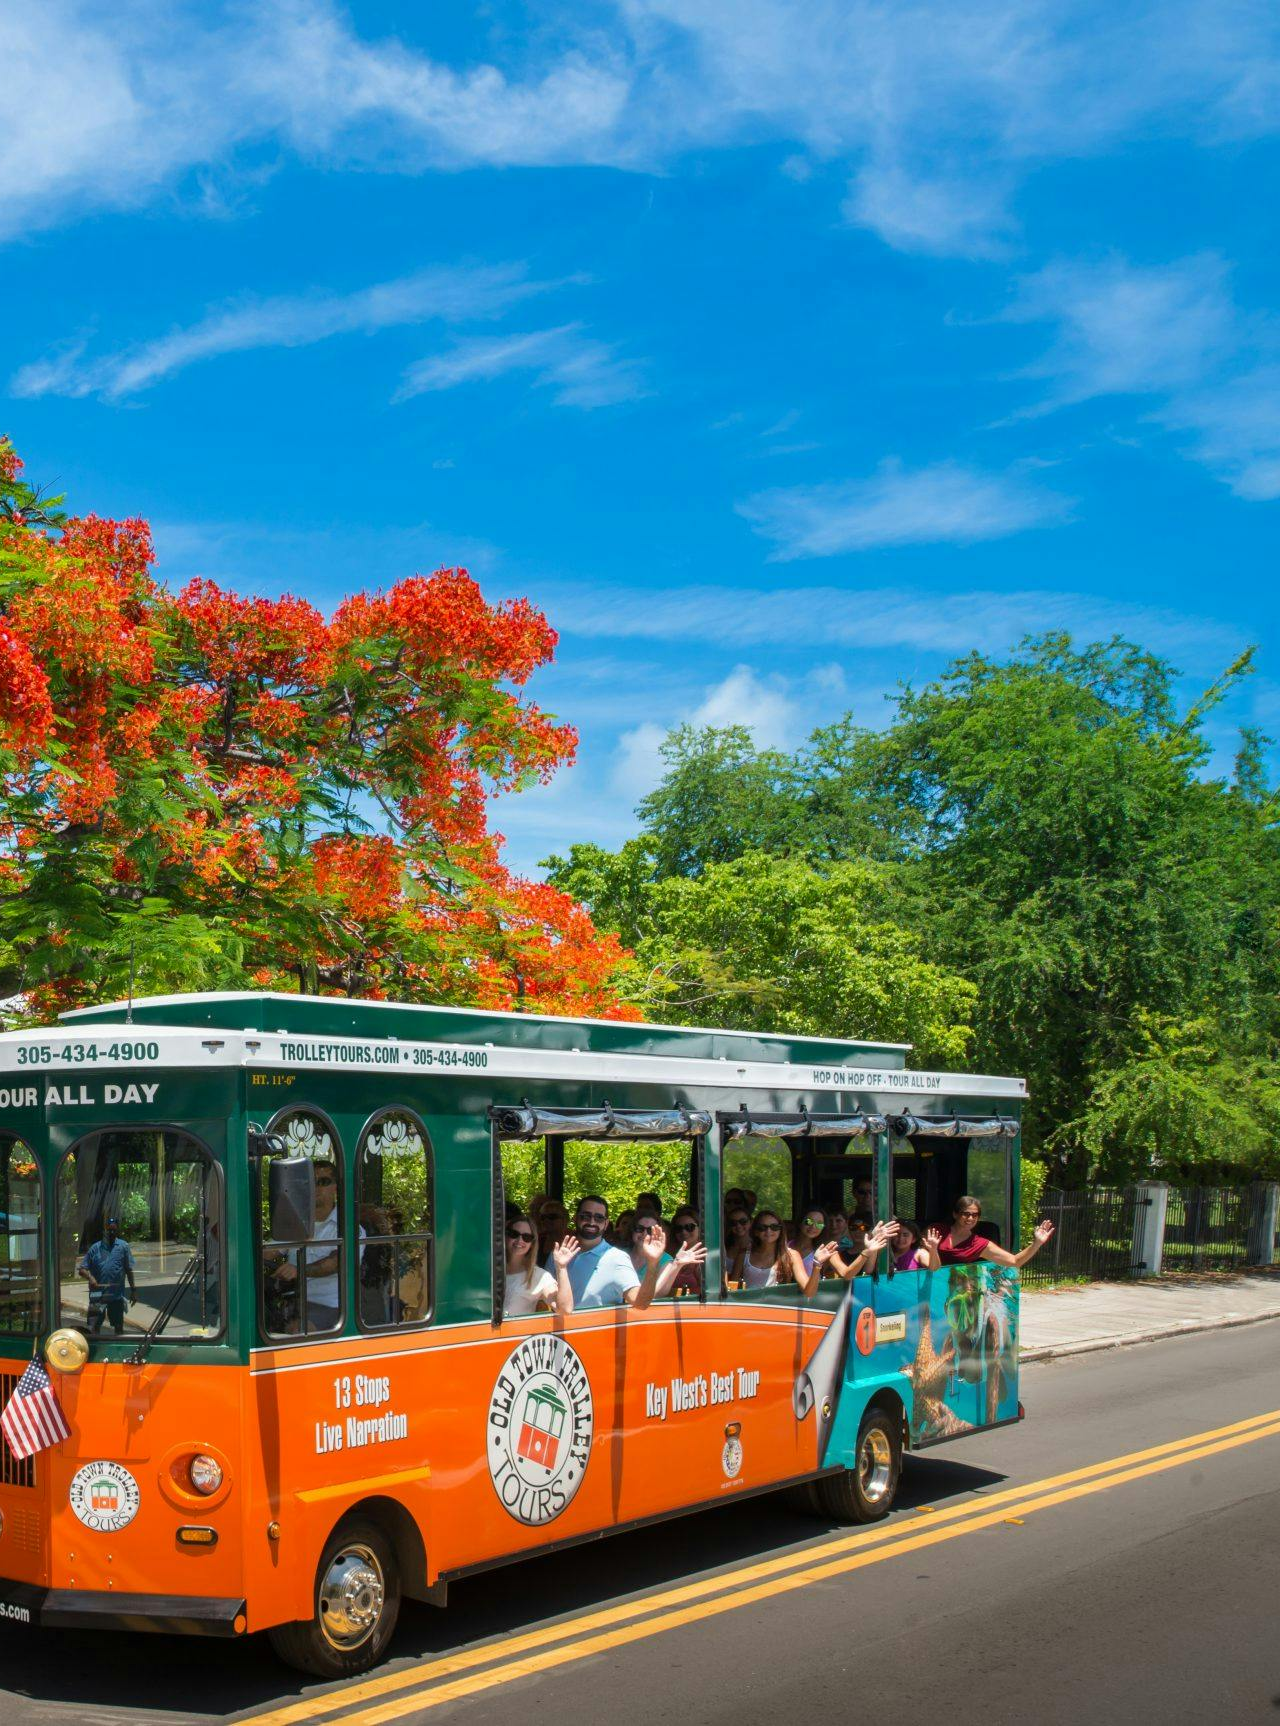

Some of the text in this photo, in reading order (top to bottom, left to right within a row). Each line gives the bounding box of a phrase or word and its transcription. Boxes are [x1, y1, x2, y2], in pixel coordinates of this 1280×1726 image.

[17, 1042, 160, 1065] 305-434-4900
[280, 1042, 488, 1068] TROLLEYTOURS.COM 305-434-4900
[44, 1085, 95, 1106] ALL
[104, 1083, 160, 1104] DAY
[252, 1074, 269, 1085] HT.
[813, 1070, 831, 1084] HOP
[833, 1071, 845, 1085] ON
[847, 1073, 865, 1085] HOP
[867, 1073, 881, 1086] OFF
[888, 1074, 908, 1087] TOUR
[911, 1076, 924, 1088] ALL
[926, 1077, 941, 1089] DAY
[334, 1374, 390, 1409] 13 Stops
[489, 1337, 592, 1470] OLD TOWN TROLLEY
[646, 1367, 760, 1422] Key West's Best Tour
[315, 1410, 408, 1454] Live Narration
[71, 1462, 139, 1506] OLD TOWN TROLLEY
[493, 1447, 569, 1523] TOURS
[80, 1508, 131, 1532] TOURS
